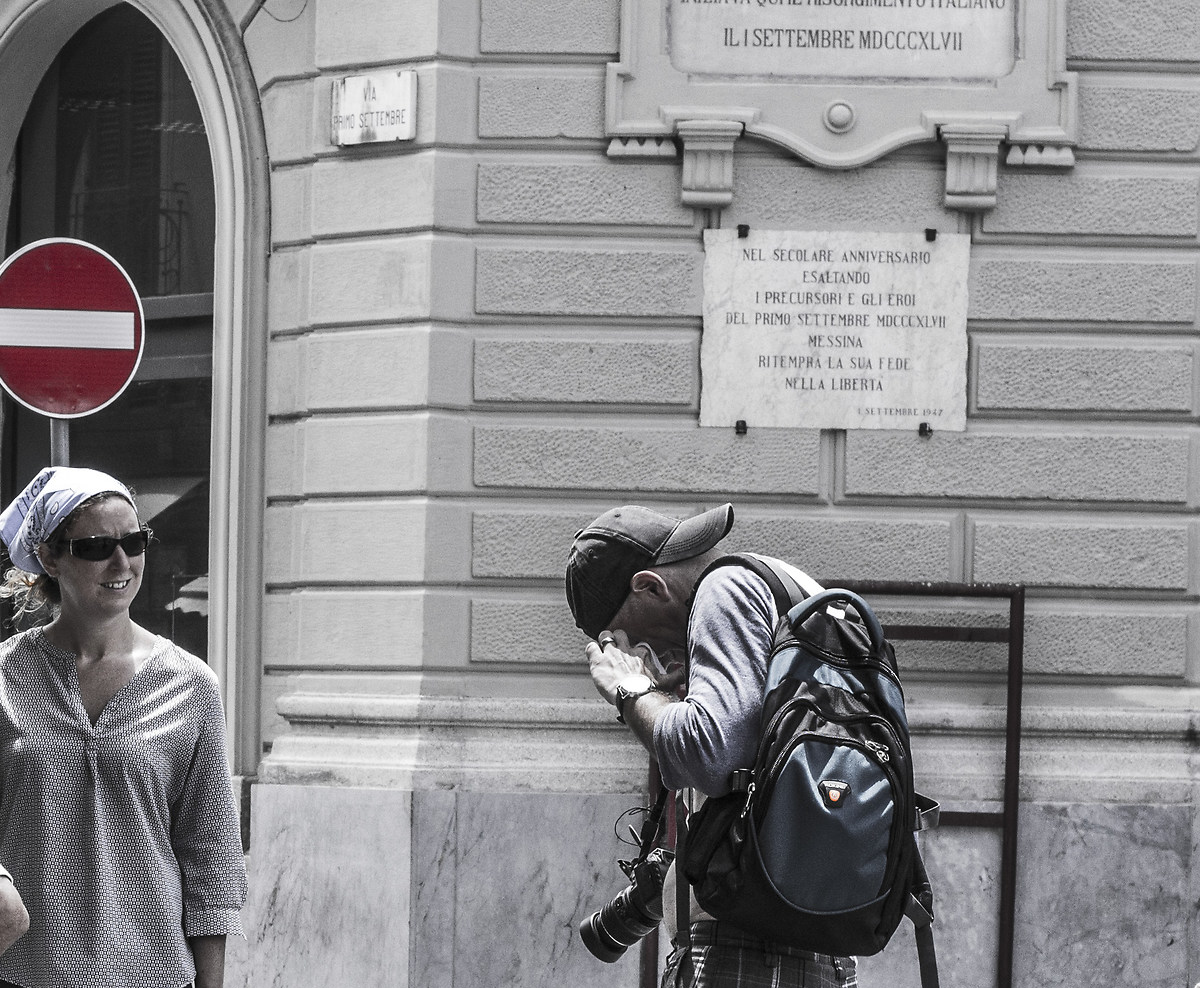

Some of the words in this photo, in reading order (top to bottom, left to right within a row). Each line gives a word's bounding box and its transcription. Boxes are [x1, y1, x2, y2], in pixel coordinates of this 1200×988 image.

[723, 28, 740, 47] IL
[752, 28, 854, 49] SETTEMBRE
[858, 30, 963, 51] MDCCCXLVII
[363, 86, 377, 101] VIA
[359, 108, 406, 128] SETTEMBRE
[742, 248, 766, 262] NEL
[773, 248, 835, 263] SECOLARE
[841, 250, 931, 265] ANNIVERSARIO
[803, 270, 871, 285] ESALTANDO
[764, 291, 843, 306] PRECURSORI
[848, 292, 856, 306] E
[861, 293, 883, 307] GLI
[888, 293, 917, 307] EROI
[725, 312, 749, 325] DEL
[754, 312, 791, 326] PRIMO
[797, 313, 871, 328] SETTEMBRE
[876, 314, 947, 329] MDCCCXLVII
[808, 335, 863, 349] MESSINA
[758, 355, 822, 369] RITEMPRA
[828, 356, 843, 369] LA
[850, 356, 873, 370] SUA
[878, 357, 911, 371] FEDE
[785, 377, 825, 391] NELLA
[865, 407, 919, 416] SETTEMBRE
